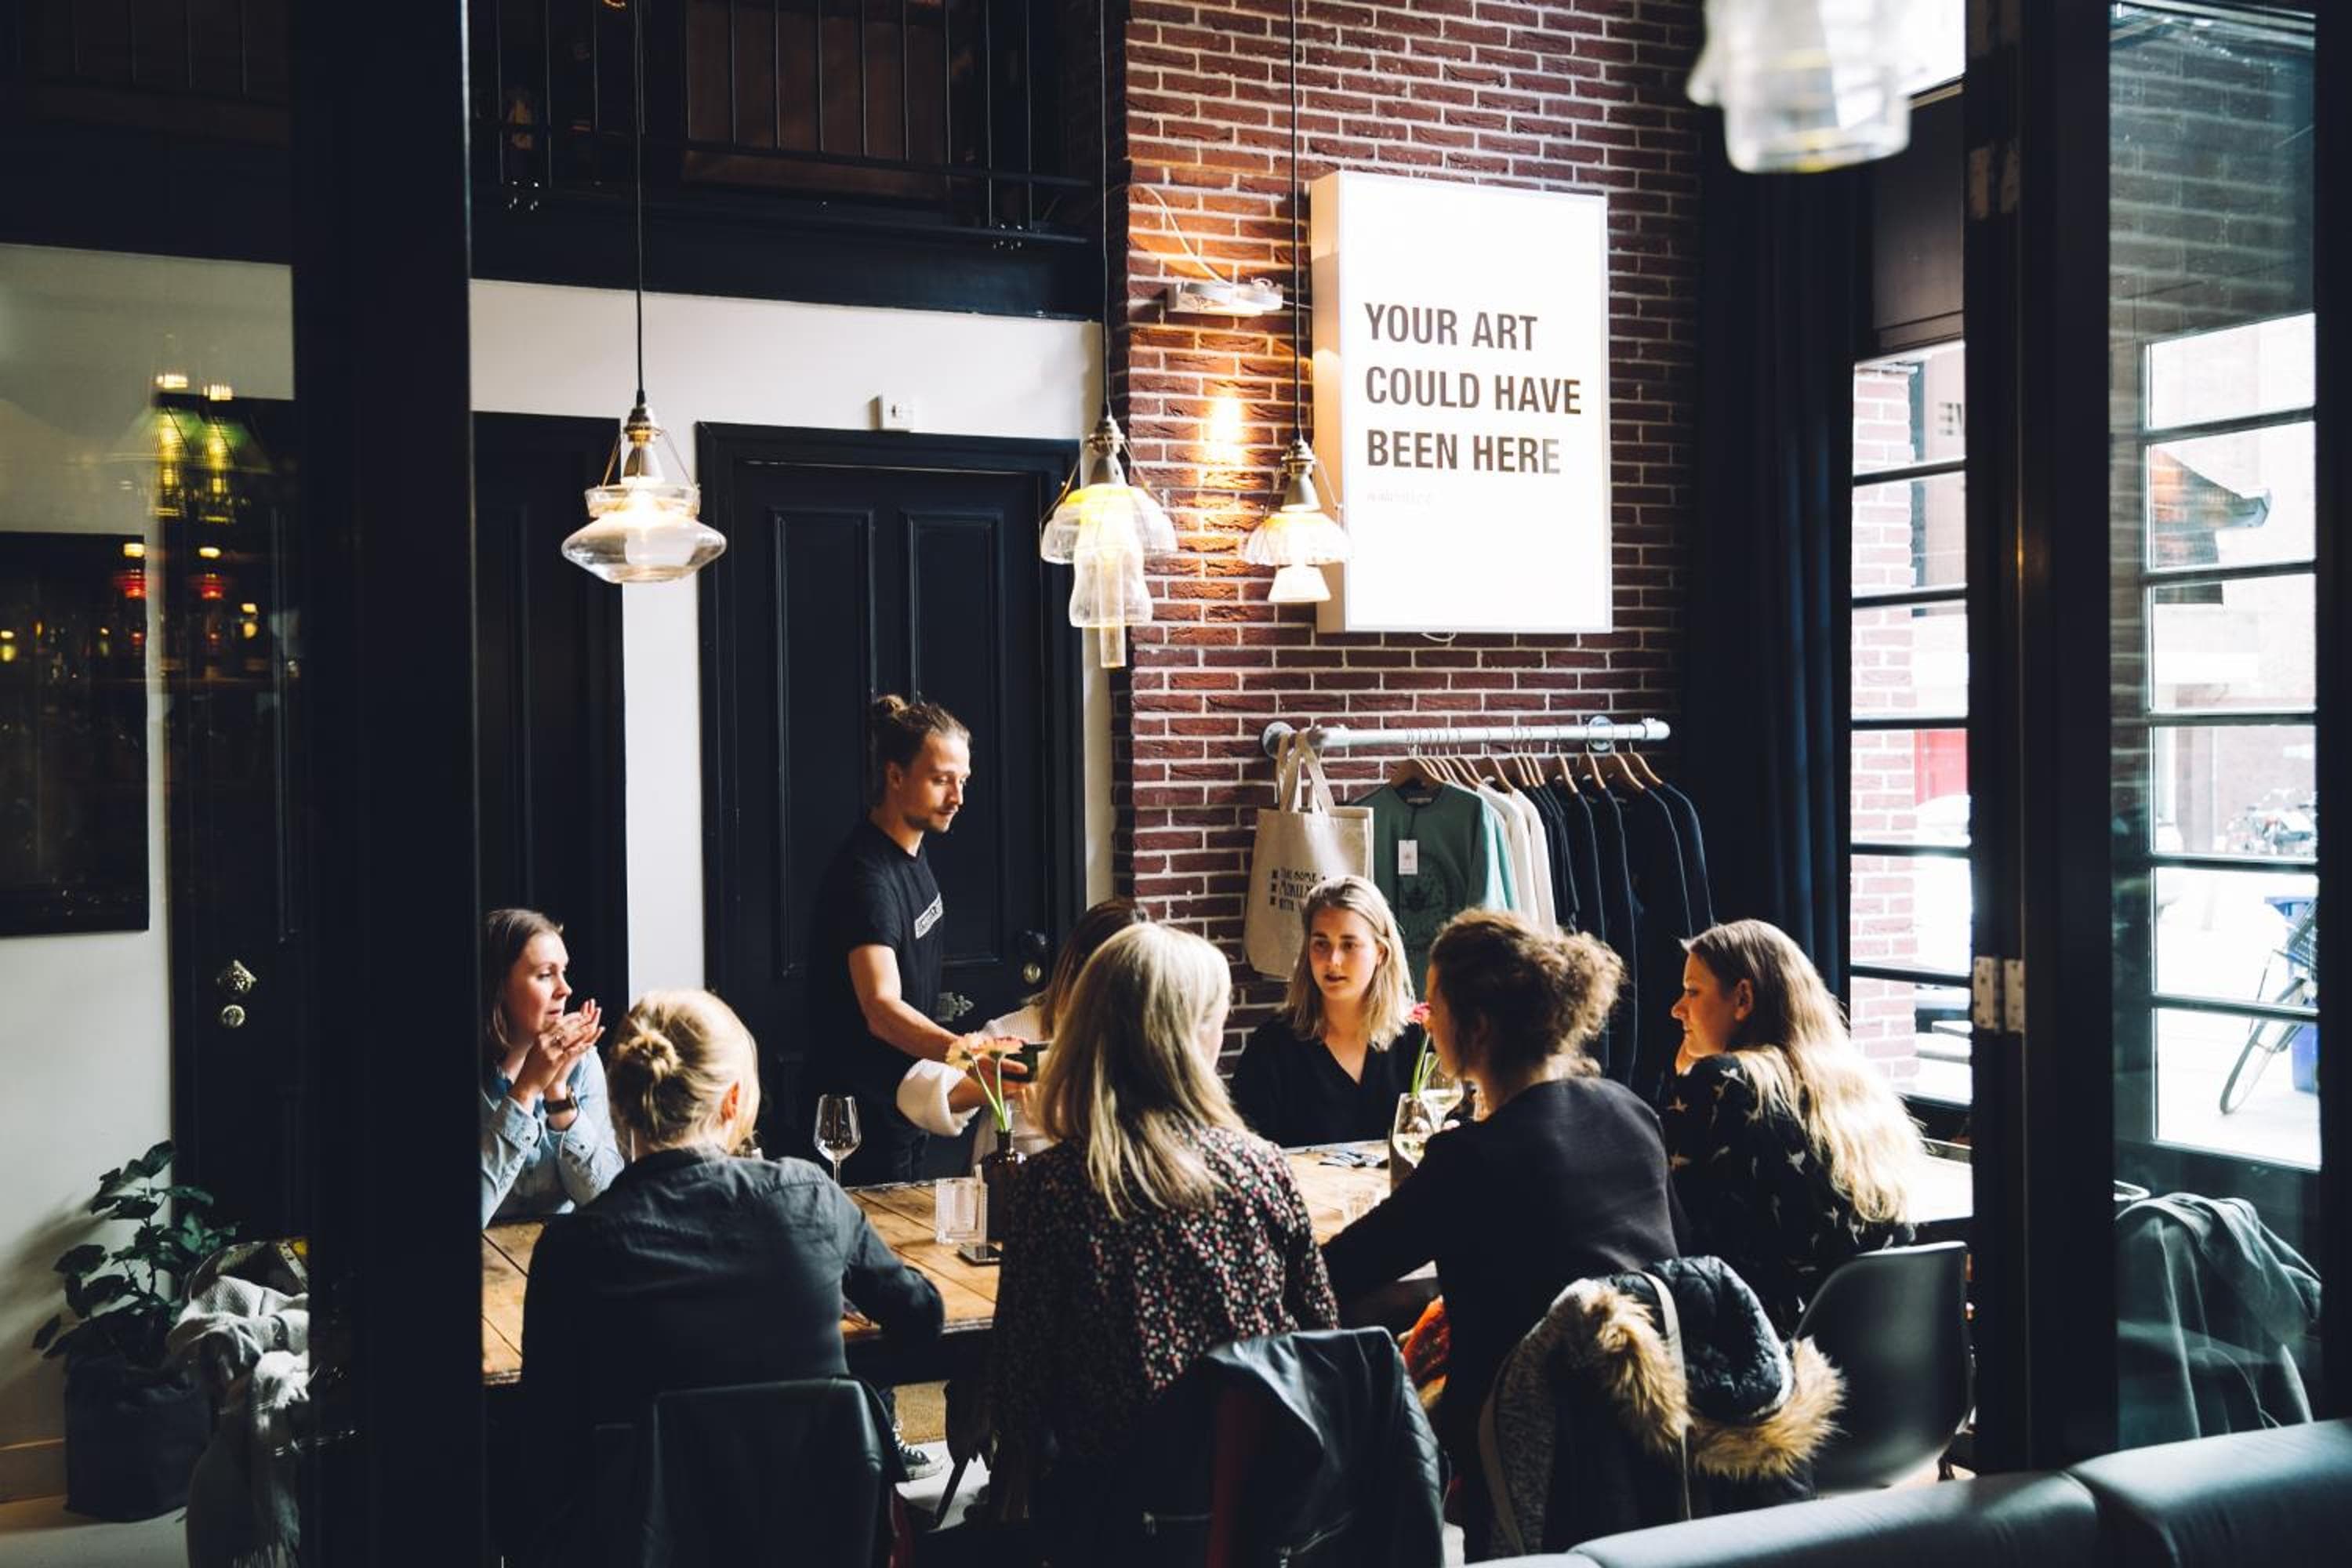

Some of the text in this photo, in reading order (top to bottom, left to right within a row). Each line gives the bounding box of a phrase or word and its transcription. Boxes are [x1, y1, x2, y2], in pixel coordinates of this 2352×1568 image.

[1364, 302, 1538, 352] YOUR ART
[1365, 365, 1582, 416] COULD HAVE
[1367, 429, 1561, 475] BEEN HERE
